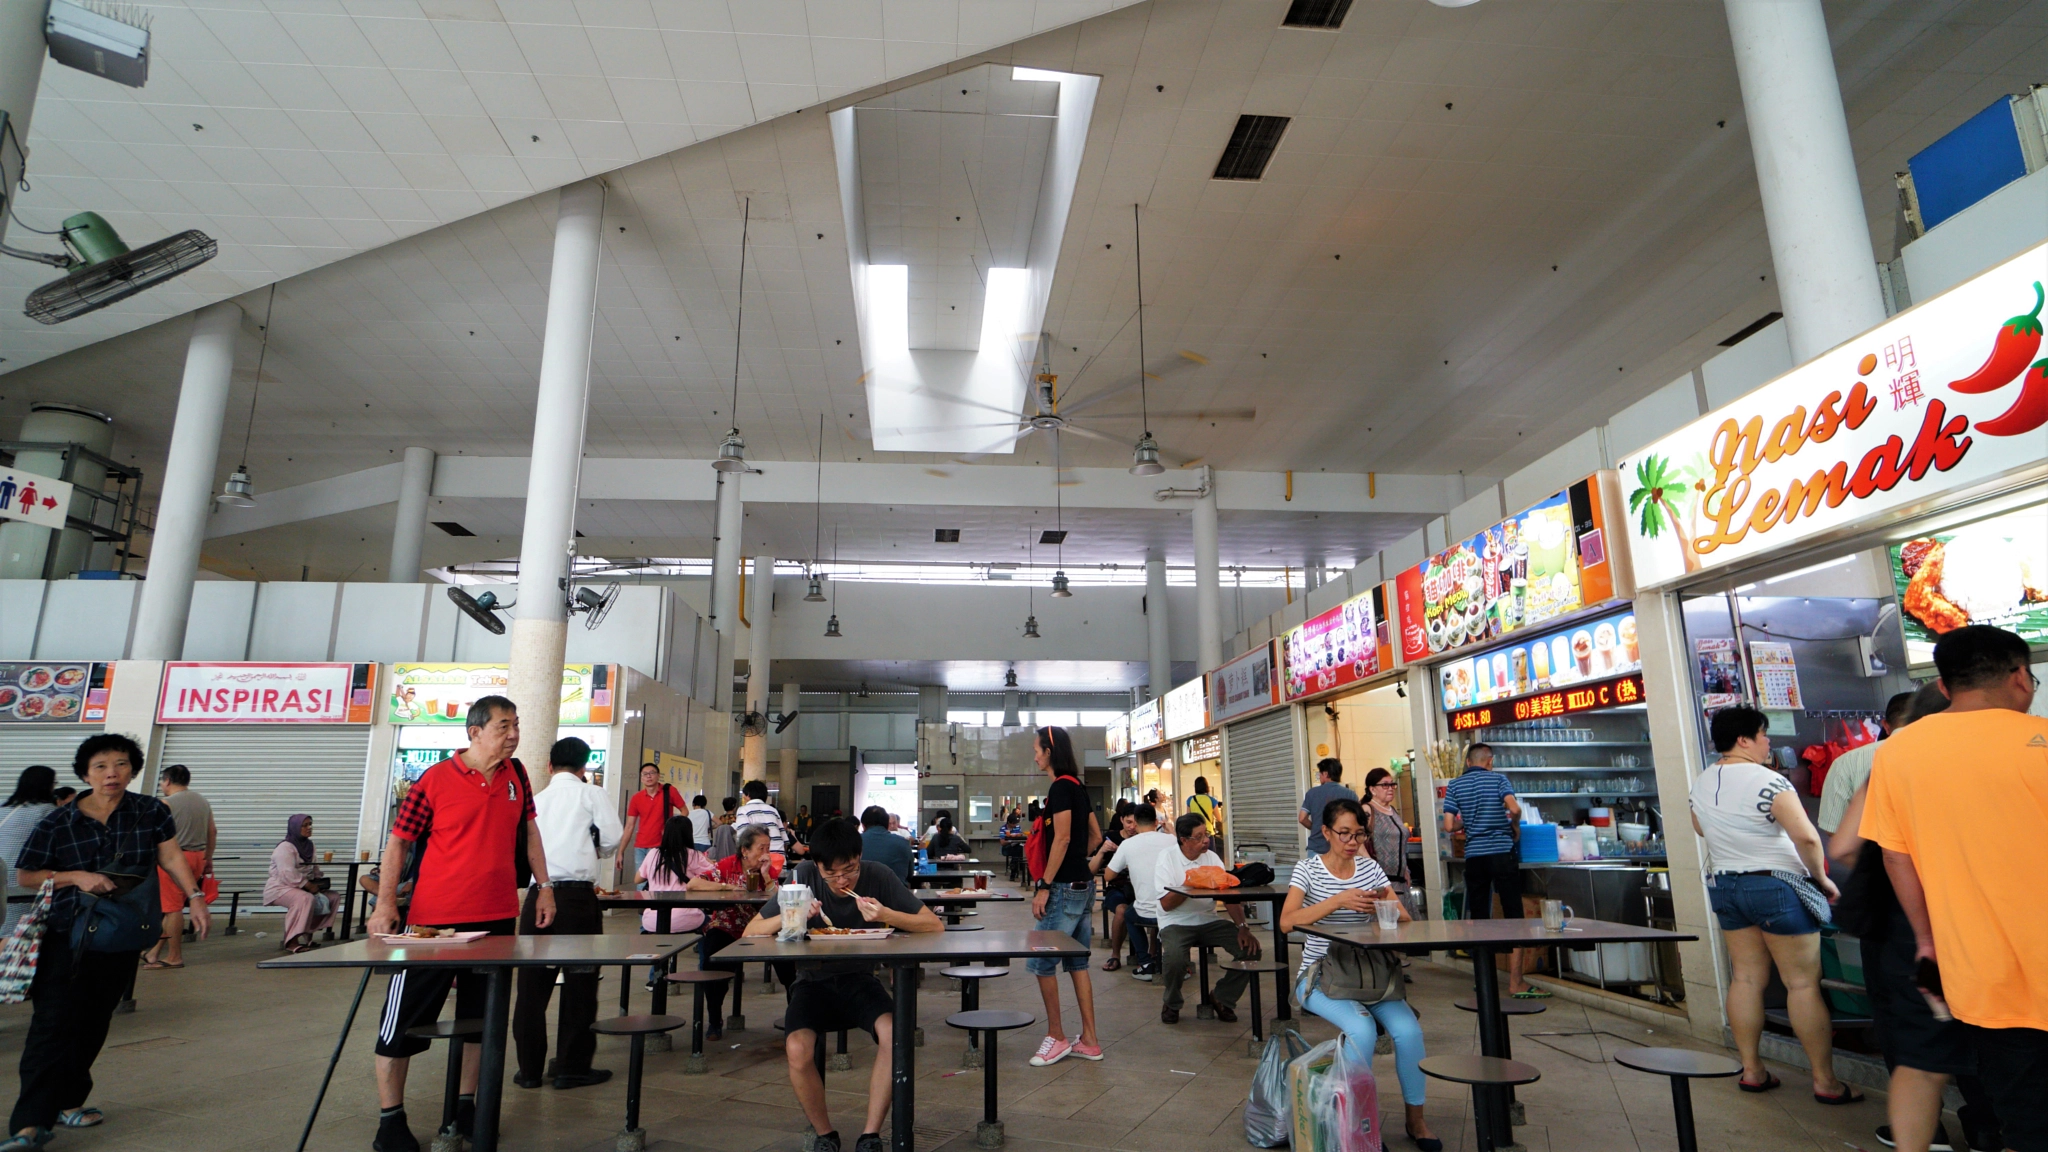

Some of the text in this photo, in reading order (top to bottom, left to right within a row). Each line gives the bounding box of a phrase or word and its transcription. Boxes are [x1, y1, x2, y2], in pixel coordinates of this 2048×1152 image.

[1884, 335, 1926, 412] 明輝
[1710, 353, 1878, 487] Nasi
[1693, 398, 1973, 555] Lemak
[1426, 590, 1469, 618] Kopi Meow
[471, 674, 508, 686] TehTa
[564, 676, 581, 685] ER
[177, 688, 332, 714] INSPIRASI
[1568, 690, 1595, 710] MILO
[1599, 687, 1609, 704] C
